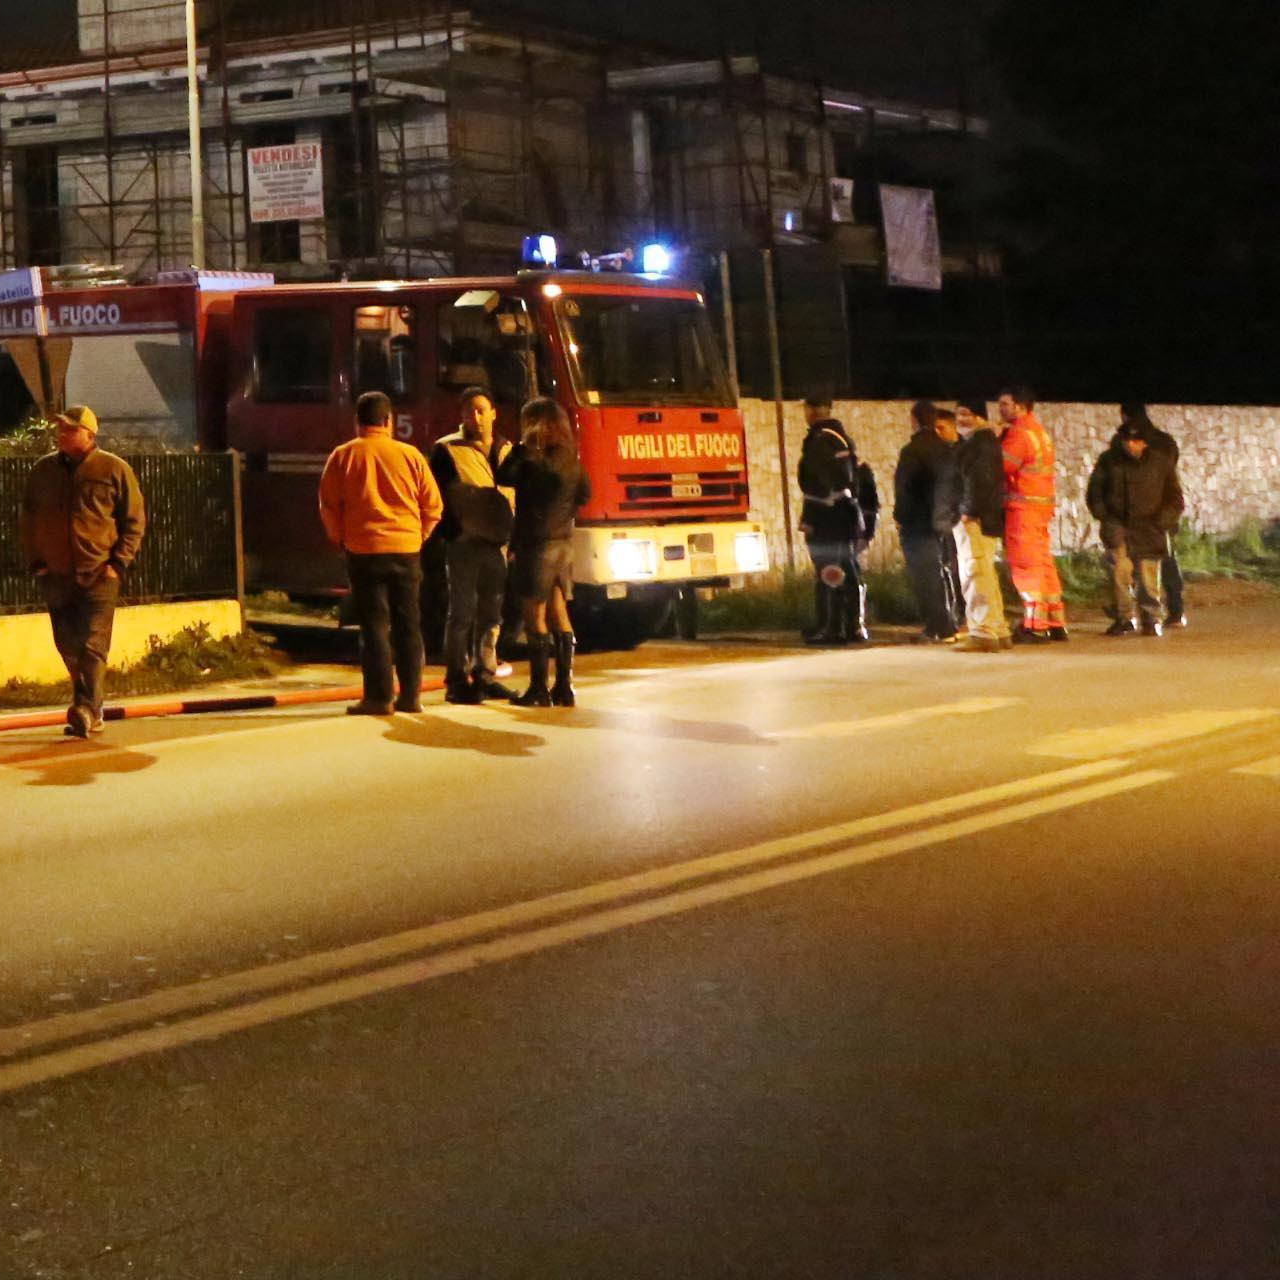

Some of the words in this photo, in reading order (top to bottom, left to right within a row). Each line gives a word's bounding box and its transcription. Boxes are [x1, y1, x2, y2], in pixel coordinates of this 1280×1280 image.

[251, 144, 317, 165] VENDESI
[22, 307, 56, 328] DL
[59, 303, 122, 326] FUOCO
[617, 433, 665, 459] VIGILI
[666, 433, 696, 458] DEL
[695, 432, 740, 457] FUOCO
